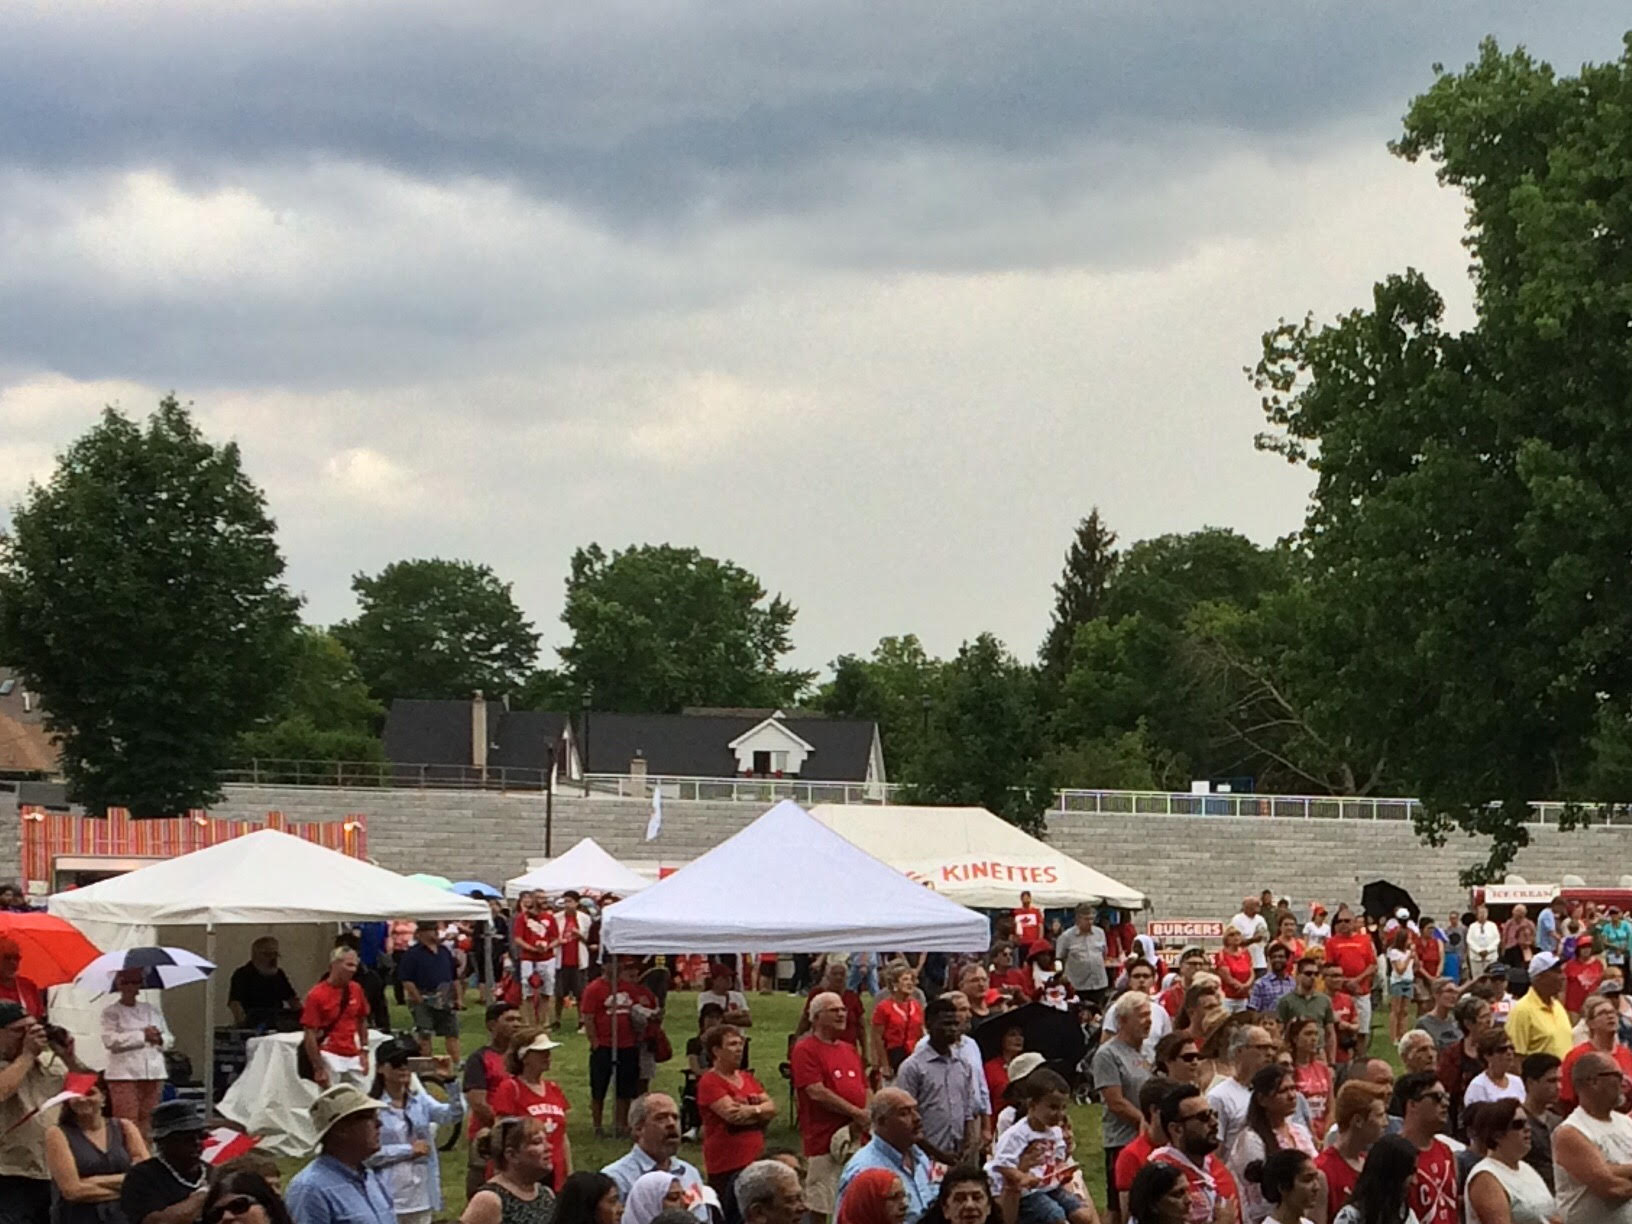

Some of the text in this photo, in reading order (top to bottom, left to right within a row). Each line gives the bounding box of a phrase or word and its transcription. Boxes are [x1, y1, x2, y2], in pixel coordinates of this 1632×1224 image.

[942, 862, 1058, 884] KINETTES
[1492, 890, 1508, 898] ICE
[1153, 923, 1221, 936] BURGERS
